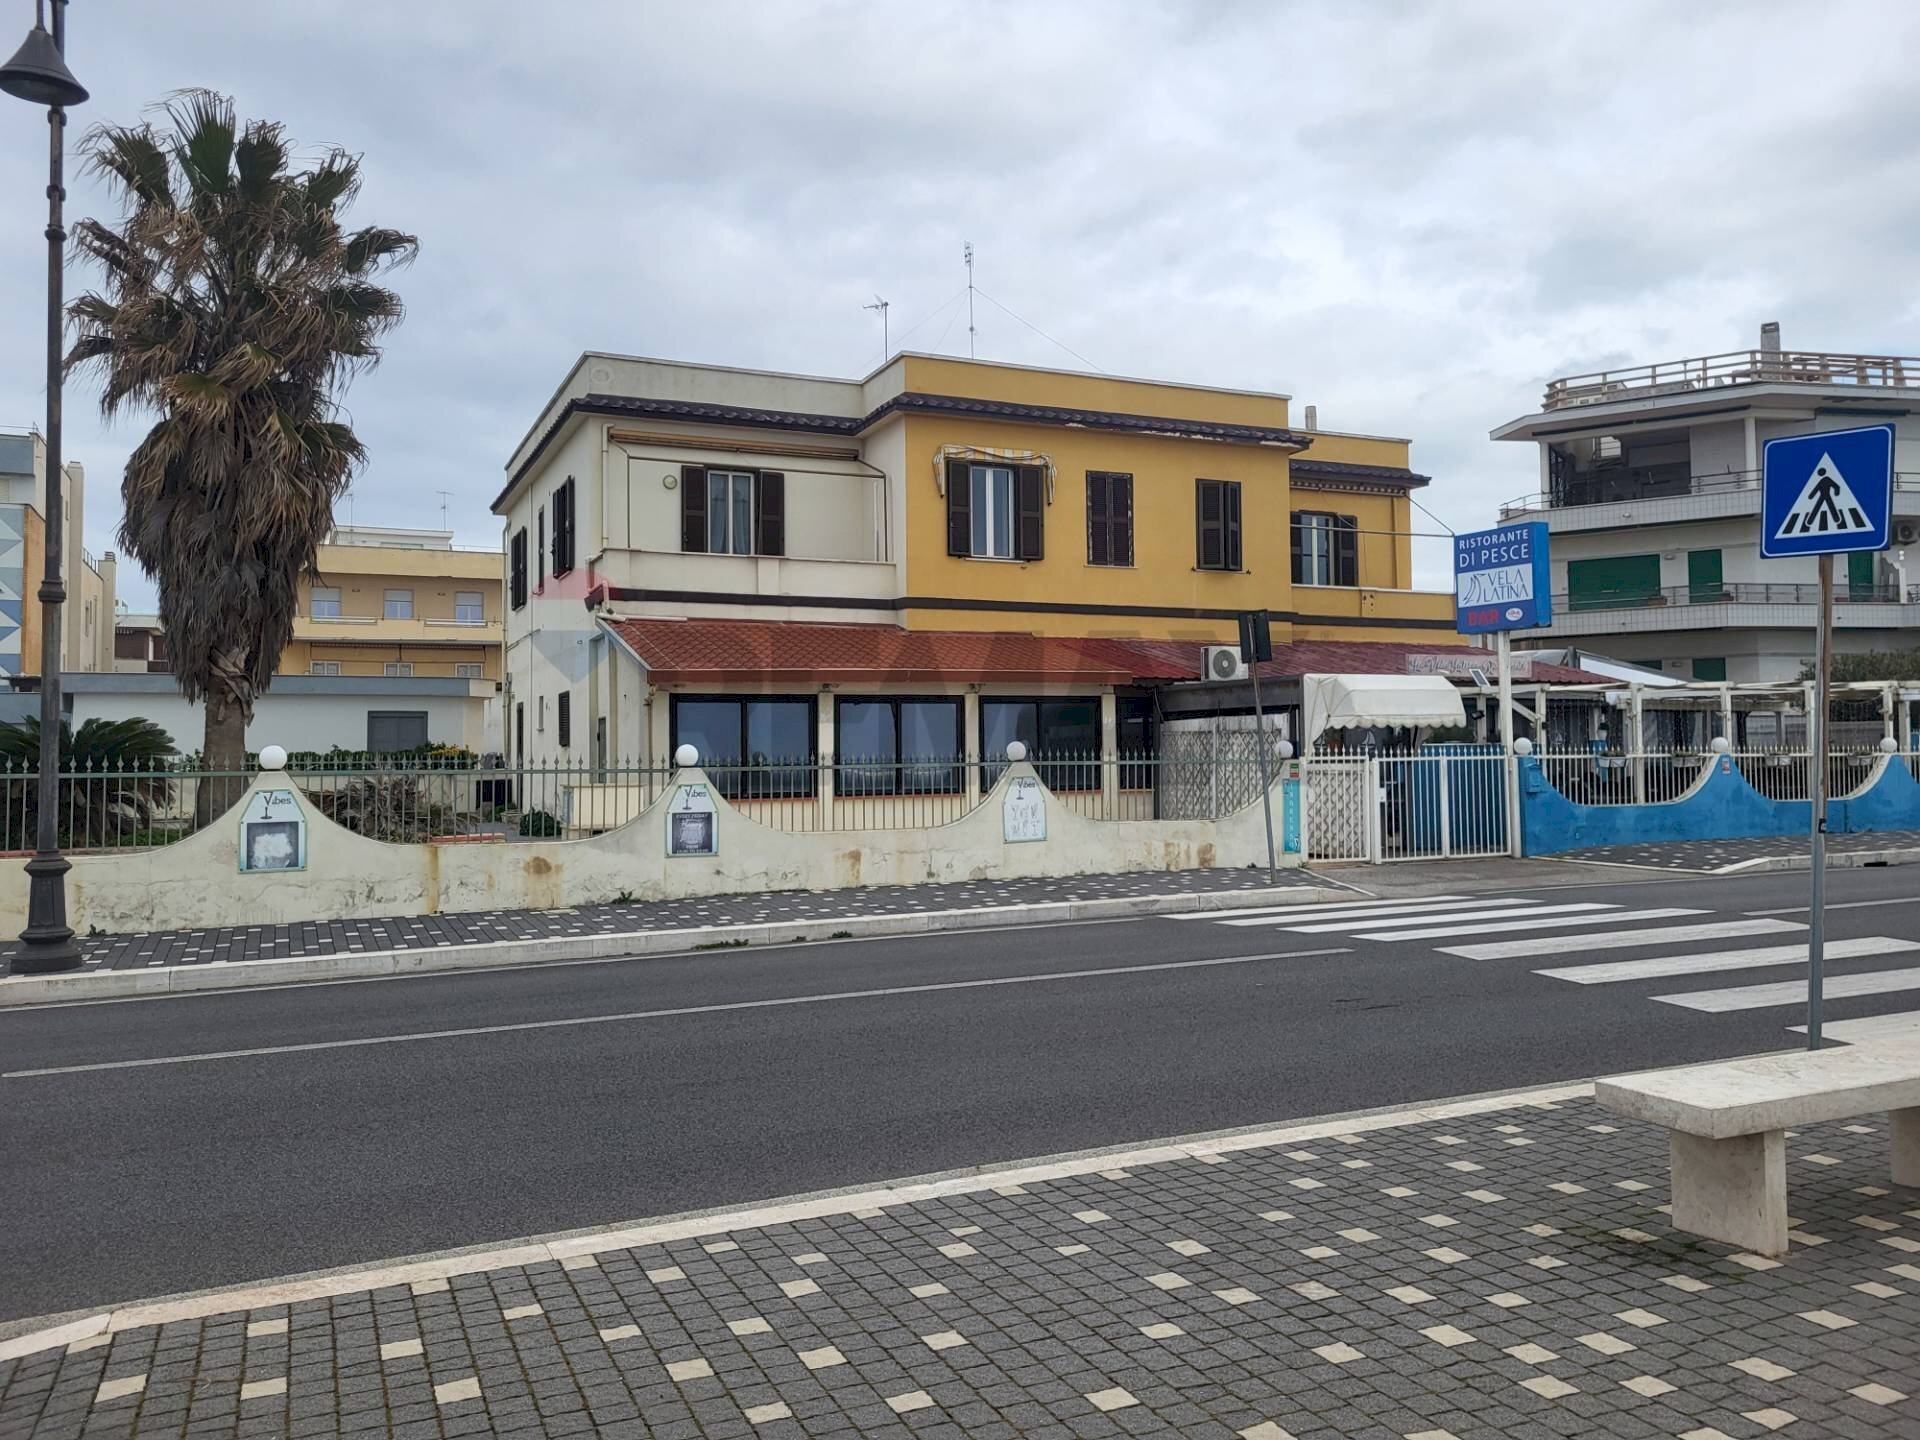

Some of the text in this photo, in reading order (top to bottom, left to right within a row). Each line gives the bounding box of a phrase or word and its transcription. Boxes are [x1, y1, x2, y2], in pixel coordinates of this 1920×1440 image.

[1459, 529, 1529, 550] RISTORANTE
[1459, 543, 1529, 568] DI PESCE
[1487, 569, 1524, 586] VELA
[1483, 584, 1529, 603] LATINA
[1467, 609, 1499, 626] BAR
[263, 791, 292, 808] Vibes
[684, 785, 707, 800] Vibes
